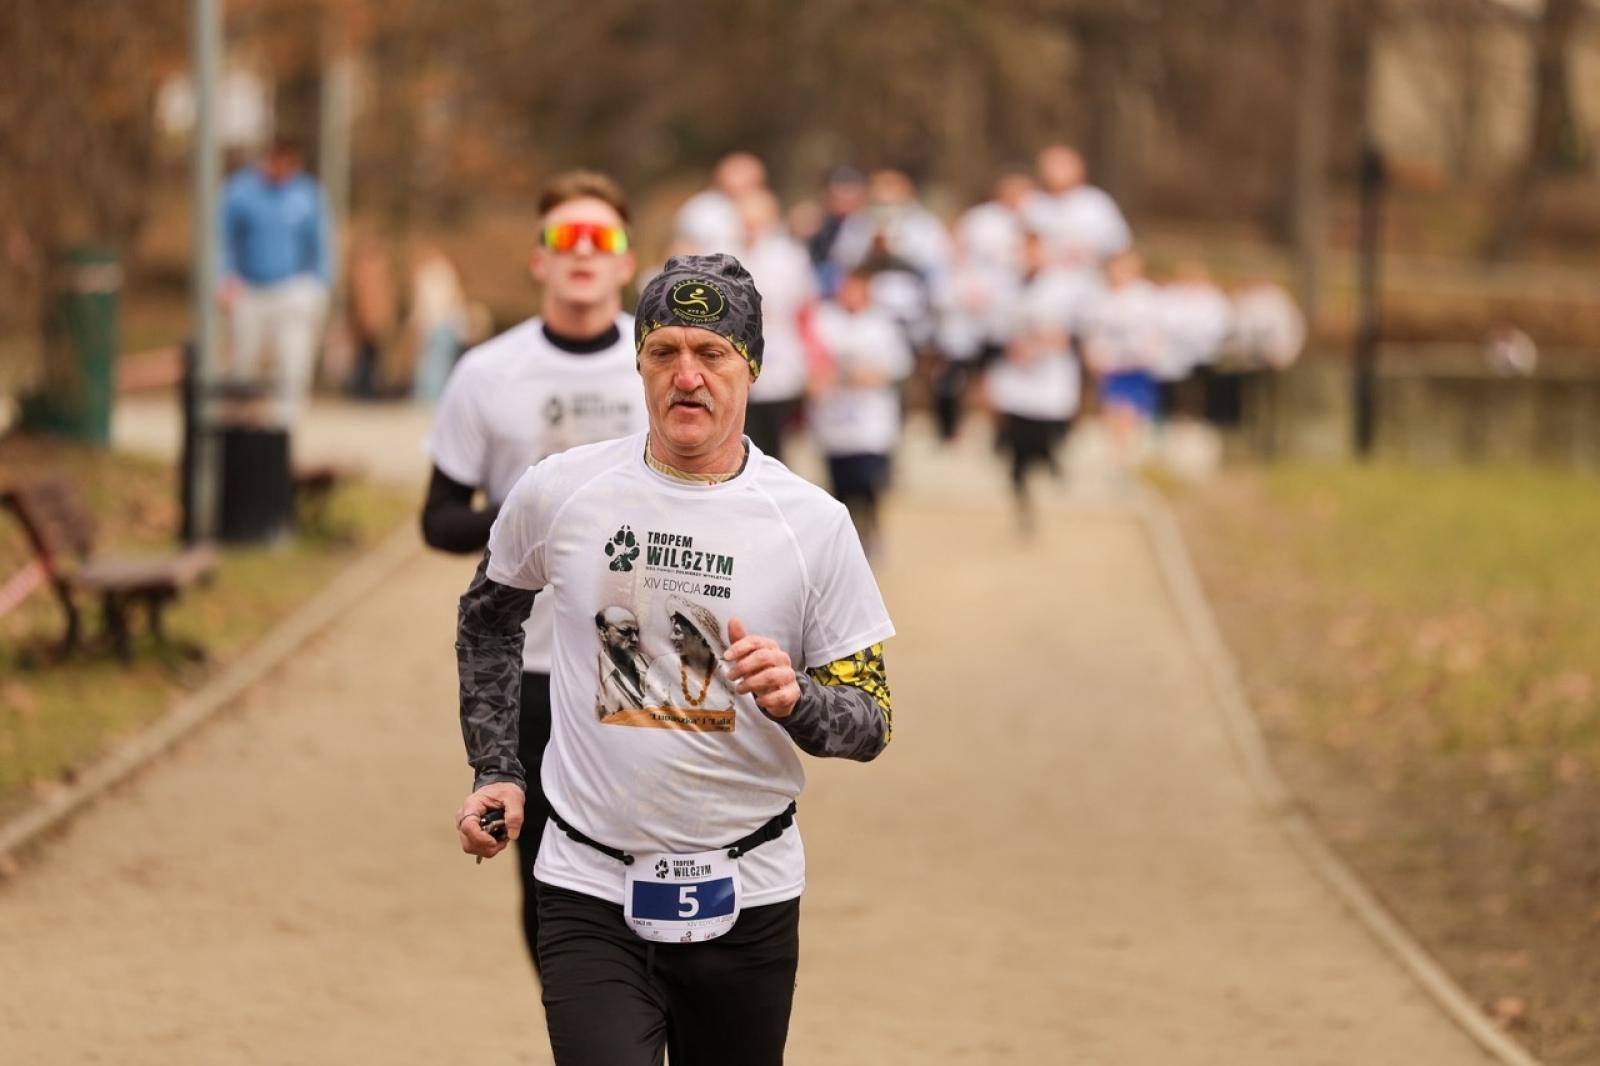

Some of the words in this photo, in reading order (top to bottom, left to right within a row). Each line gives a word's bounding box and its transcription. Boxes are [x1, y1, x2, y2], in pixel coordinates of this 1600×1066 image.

[648, 531, 693, 548] TROPEM
[647, 546, 734, 576] WILCZYM
[643, 577, 661, 589] XIV
[663, 579, 700, 594] EDYCJA
[703, 584, 731, 599] 2026
[673, 864, 712, 877] WILCZYM
[678, 886, 700, 917] 5
